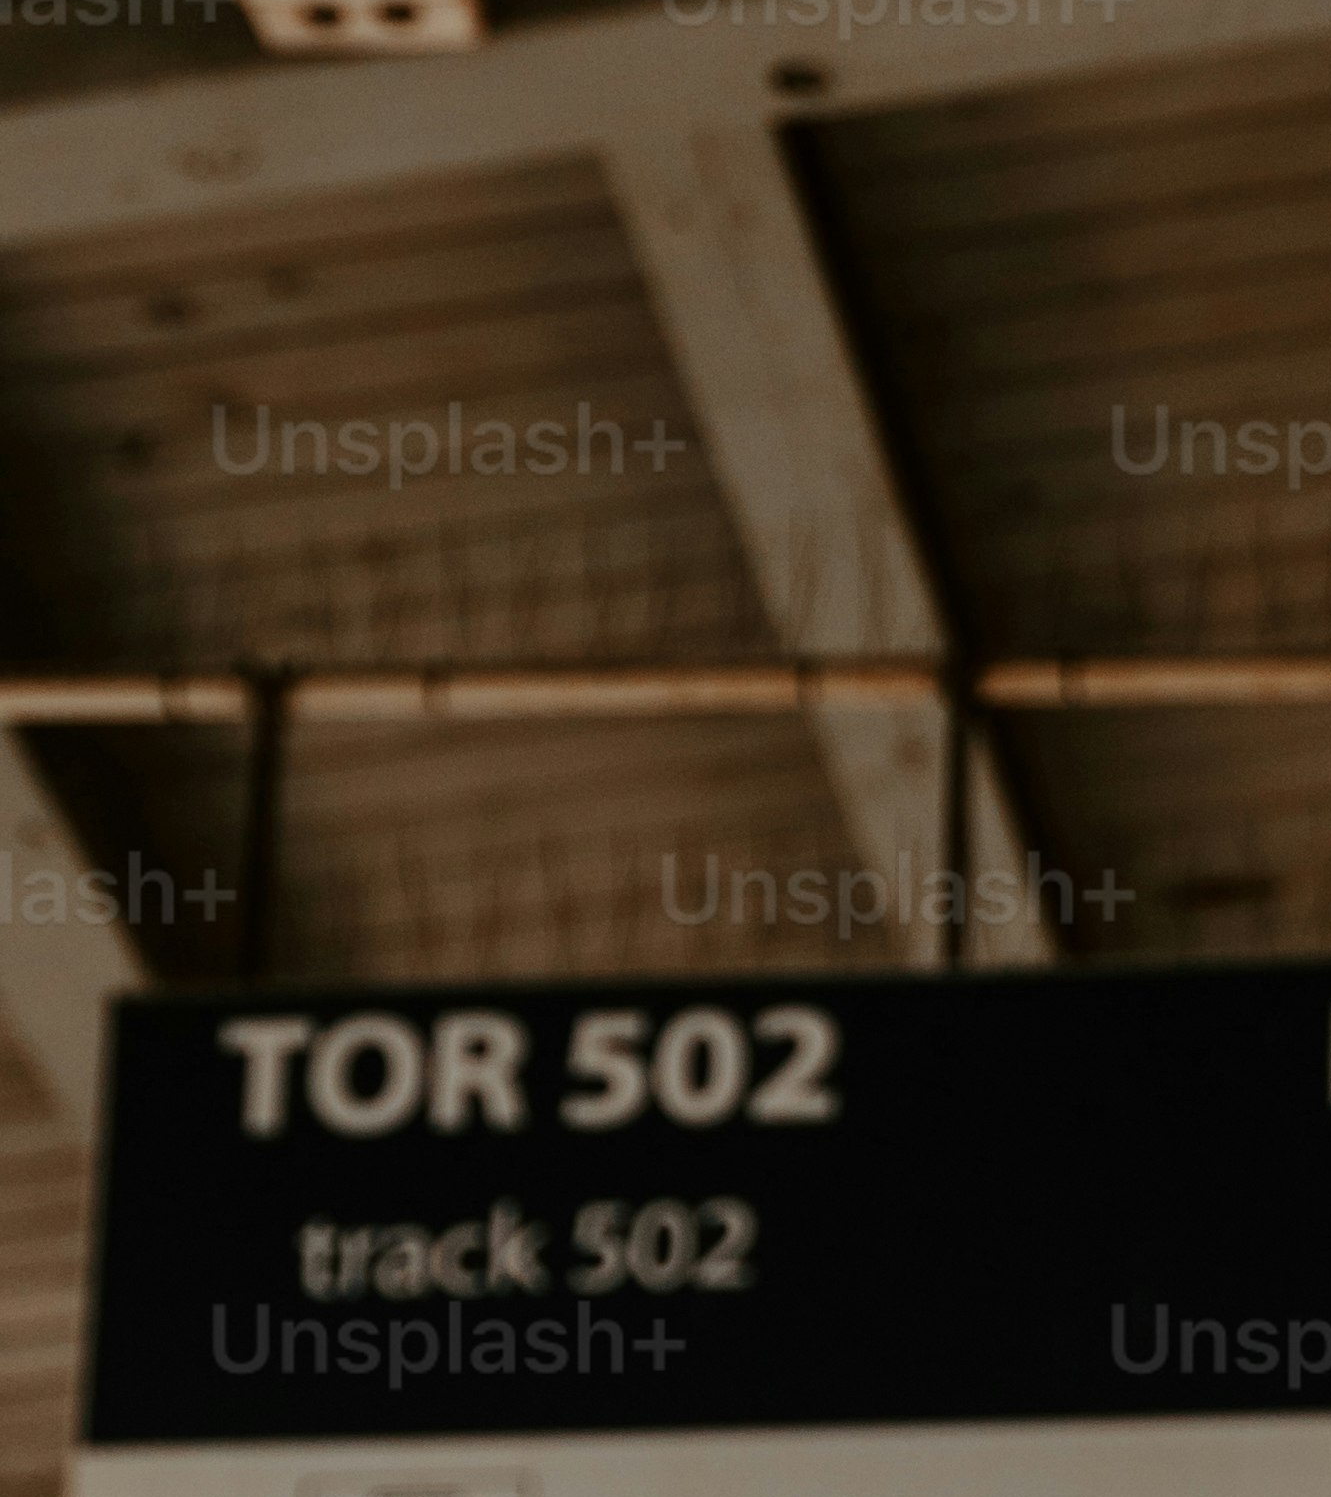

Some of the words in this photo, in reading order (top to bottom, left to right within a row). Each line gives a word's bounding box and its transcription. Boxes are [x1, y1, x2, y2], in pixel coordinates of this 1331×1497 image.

[219, 1010, 527, 1138] TOR
[560, 1004, 838, 1130] 502
[299, 1205, 545, 1299] track
[572, 1197, 758, 1294] 502
